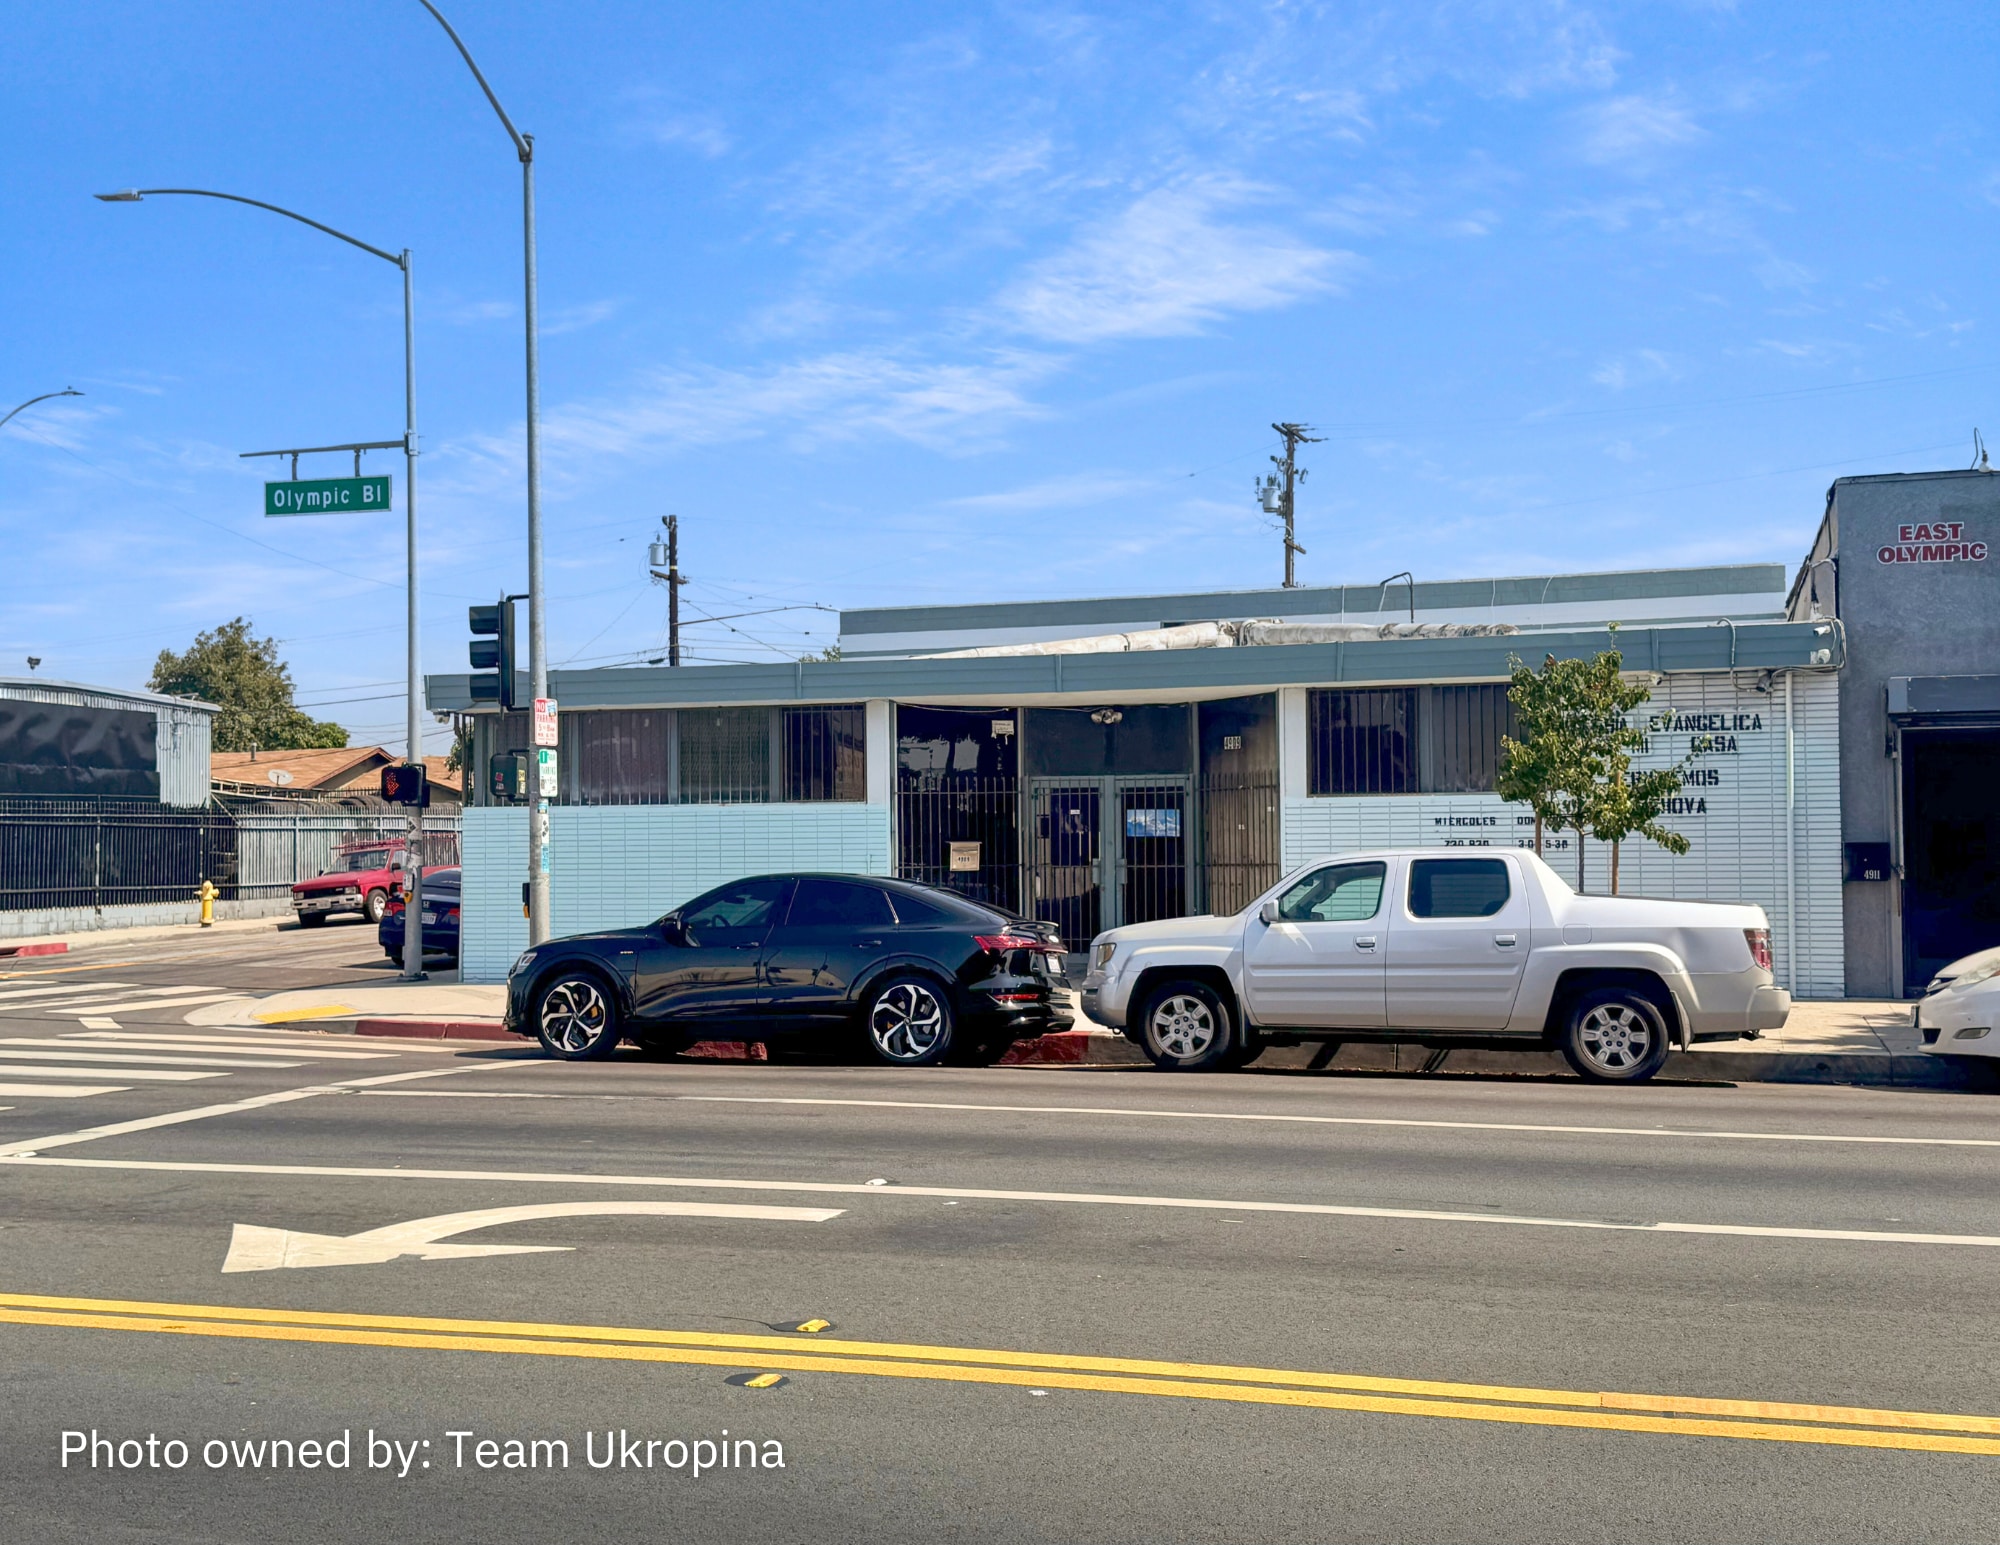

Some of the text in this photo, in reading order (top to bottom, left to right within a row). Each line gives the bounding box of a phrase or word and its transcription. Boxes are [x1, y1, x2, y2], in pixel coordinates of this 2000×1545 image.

[273, 485, 381, 511] Olympic Bl
[1898, 522, 1964, 543] EAST
[1877, 542, 1987, 564] OLYMPIC
[1649, 714, 1762, 732] EVANGELICA
[1691, 735, 1737, 753] CASA
[1864, 870, 1880, 879] 4911
